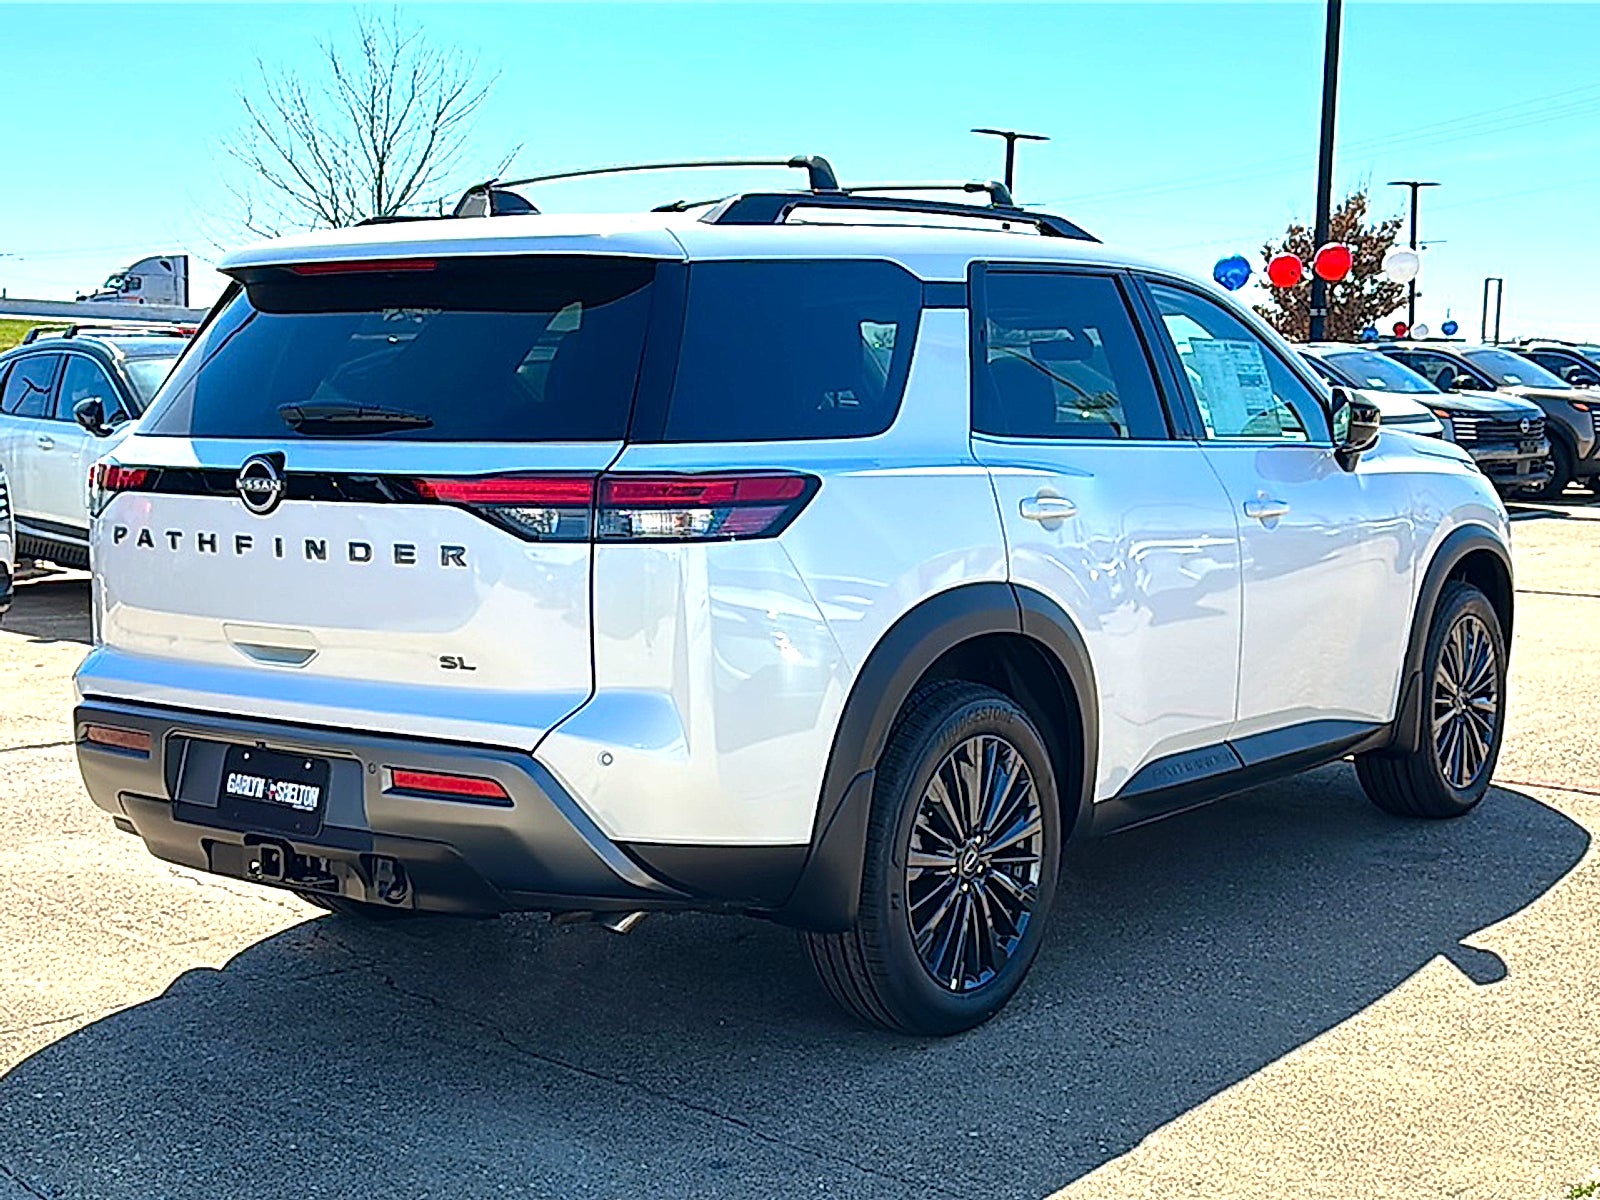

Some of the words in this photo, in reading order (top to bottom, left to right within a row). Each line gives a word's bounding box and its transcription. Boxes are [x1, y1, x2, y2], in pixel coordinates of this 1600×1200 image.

[236, 478, 281, 491] NISSAN
[113, 525, 467, 567] PATHFINDER
[439, 655, 477, 671] SL
[275, 781, 320, 808] SHELTON
